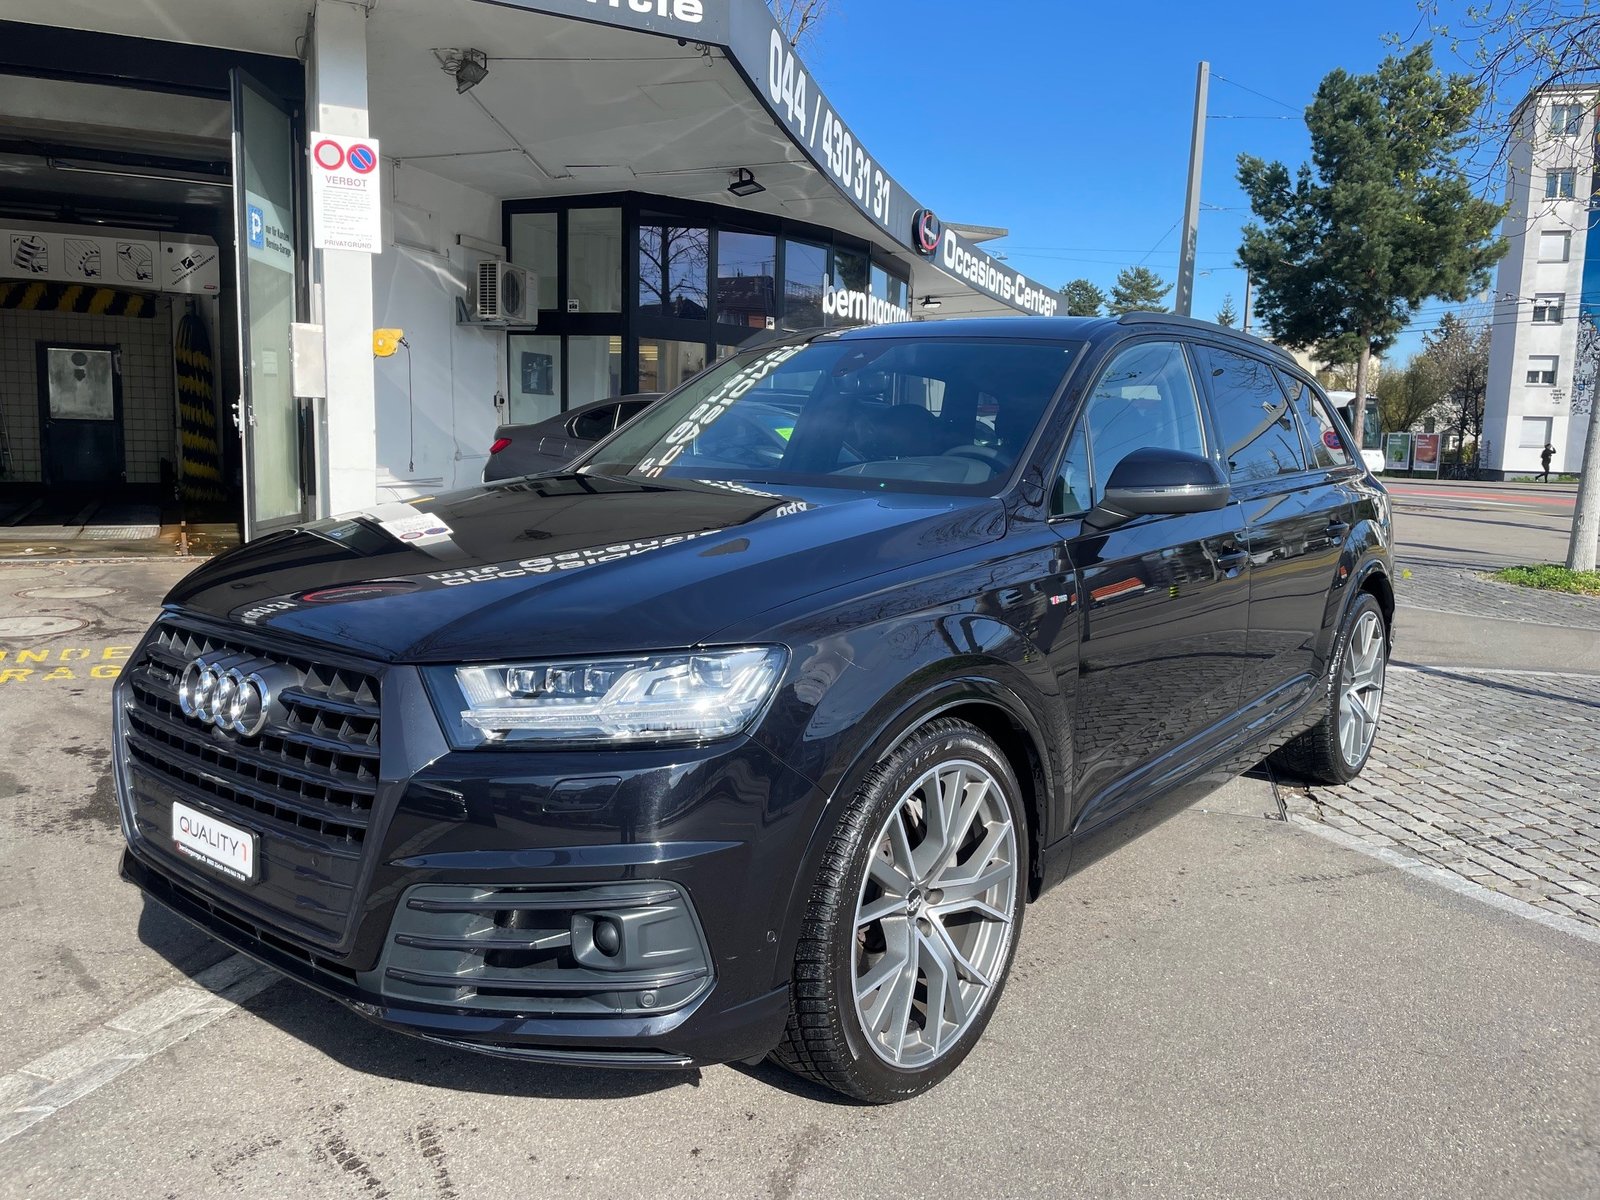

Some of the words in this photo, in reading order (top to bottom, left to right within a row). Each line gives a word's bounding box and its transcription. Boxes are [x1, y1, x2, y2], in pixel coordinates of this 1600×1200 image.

[769, 28, 807, 138] 044
[822, 109, 853, 188] 430
[854, 146, 871, 208] 31
[873, 169, 891, 226] 31
[325, 174, 368, 188] VERBOT
[324, 238, 372, 250] PRIVATGRUND
